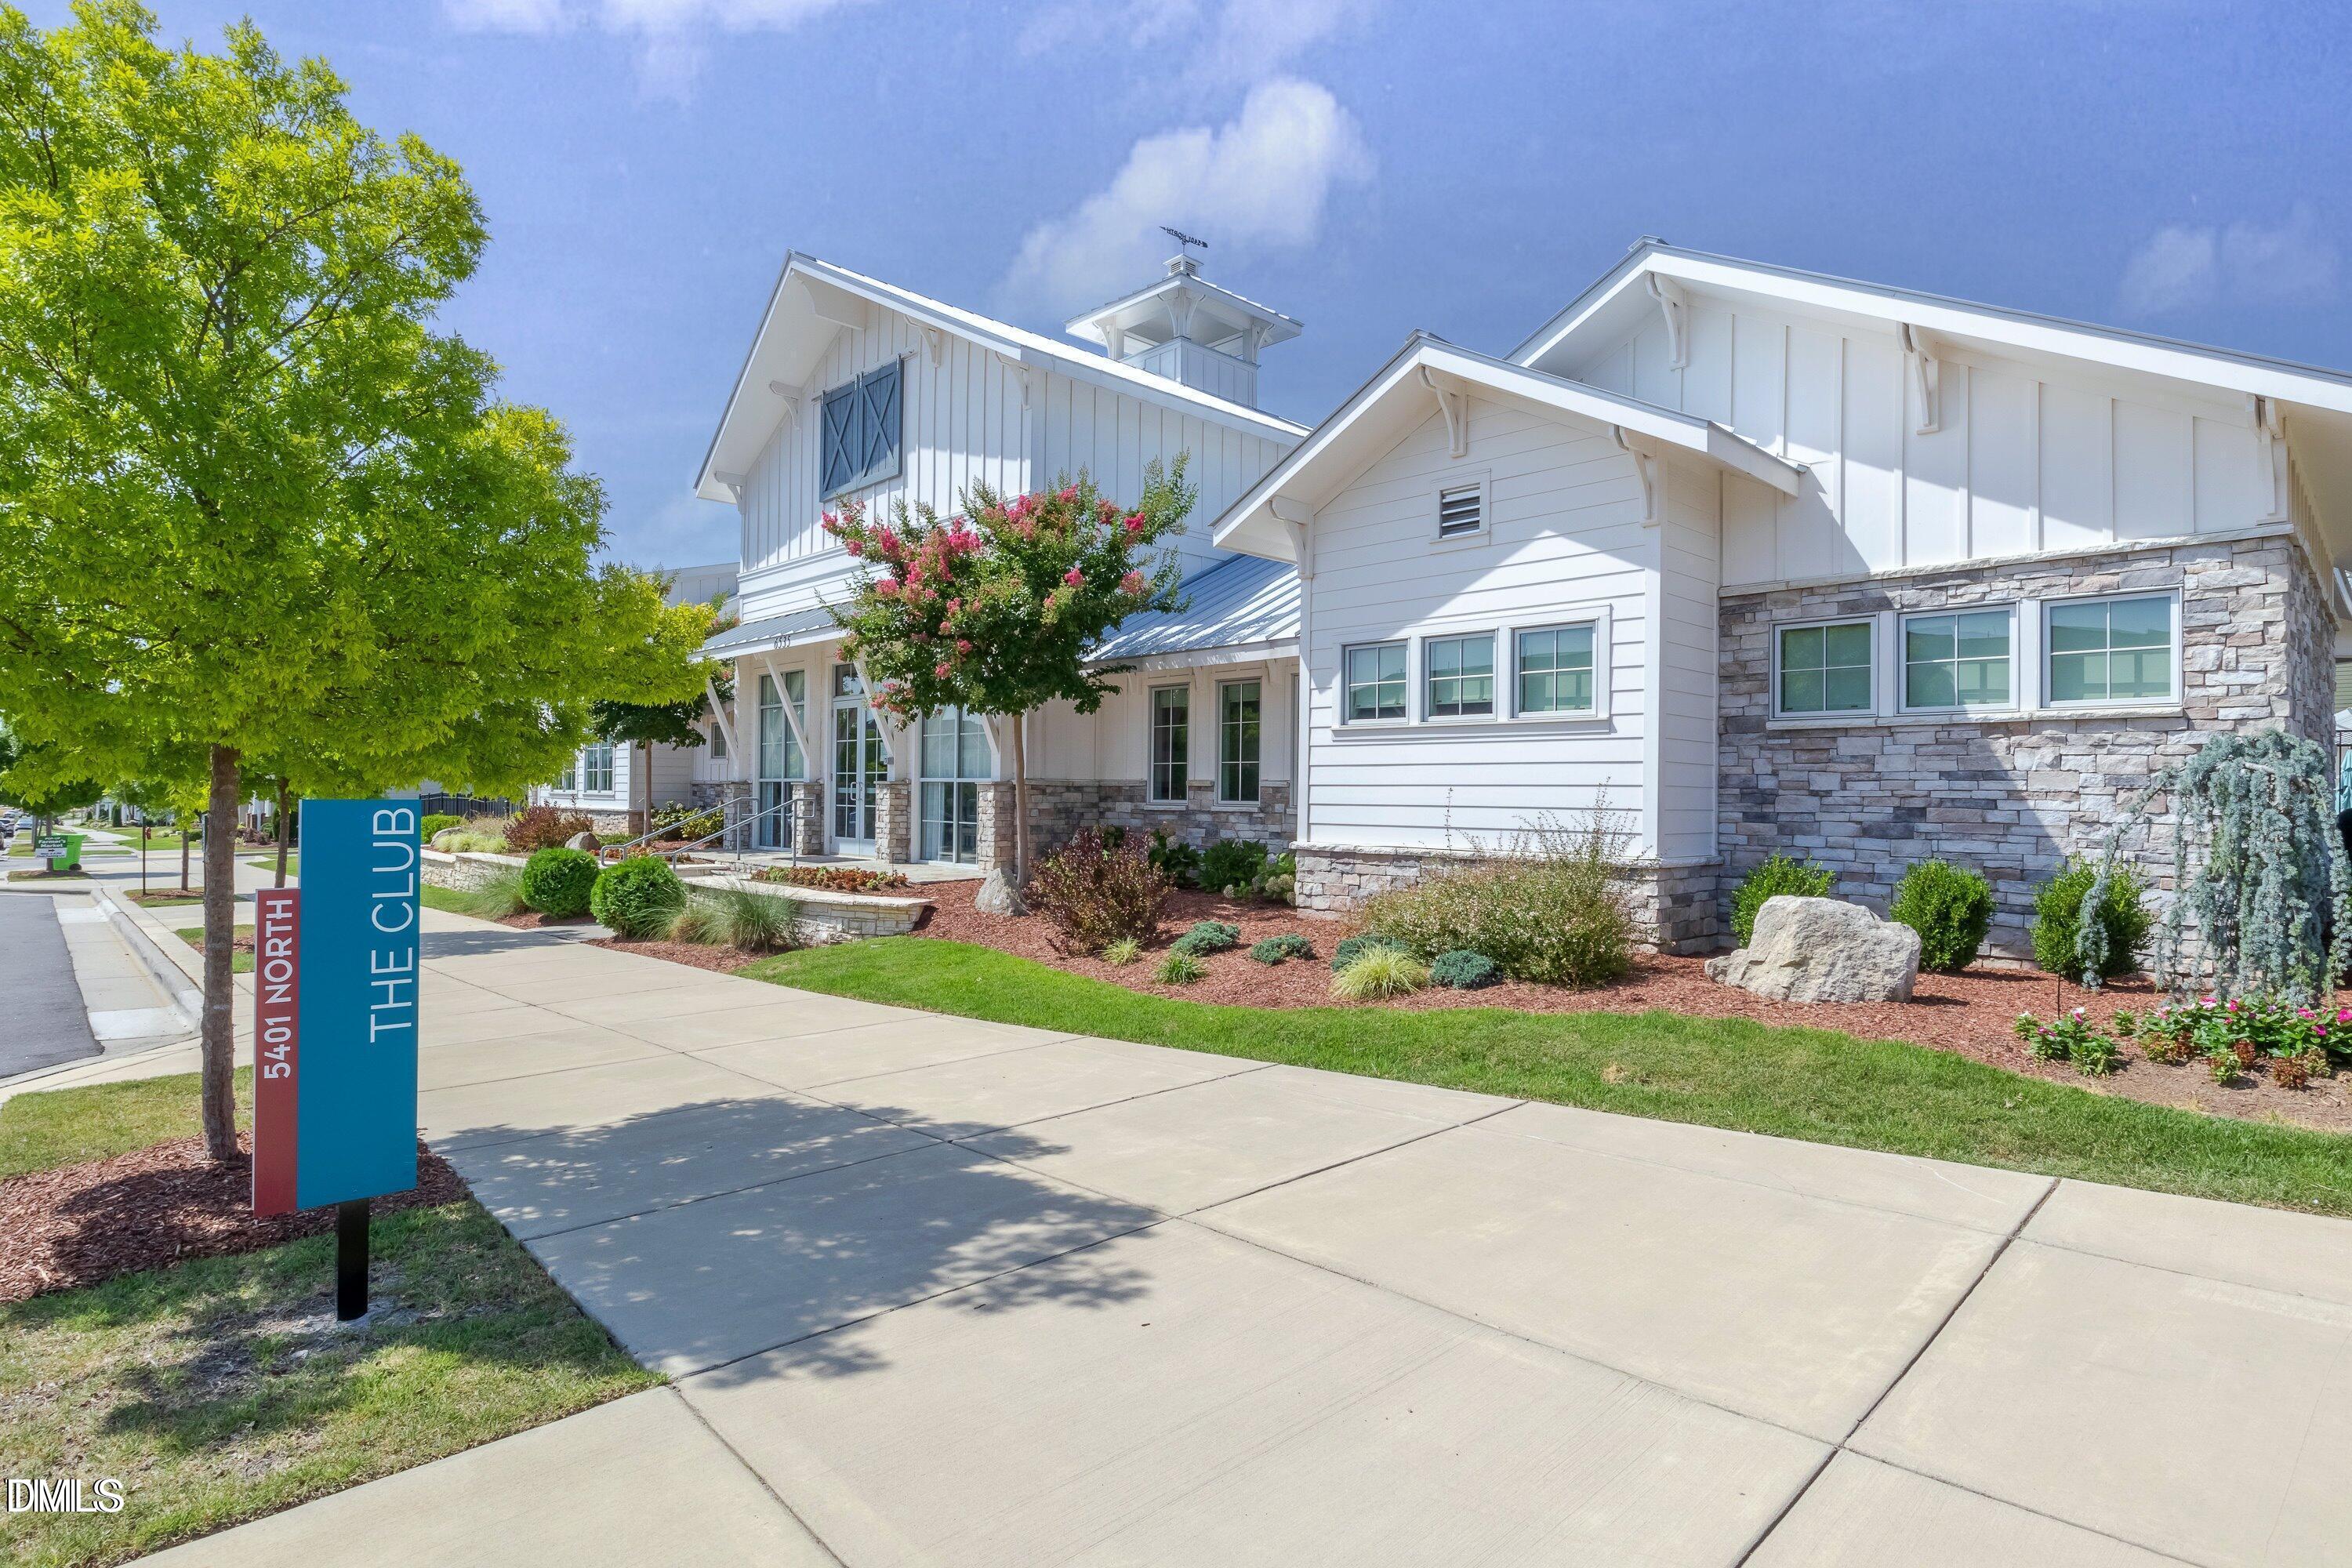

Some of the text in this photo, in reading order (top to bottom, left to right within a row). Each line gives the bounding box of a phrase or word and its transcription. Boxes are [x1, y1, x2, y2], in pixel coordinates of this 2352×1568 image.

[263, 899, 293, 1079] 5401 NORTH
[370, 808, 415, 1043] THE CLUB
